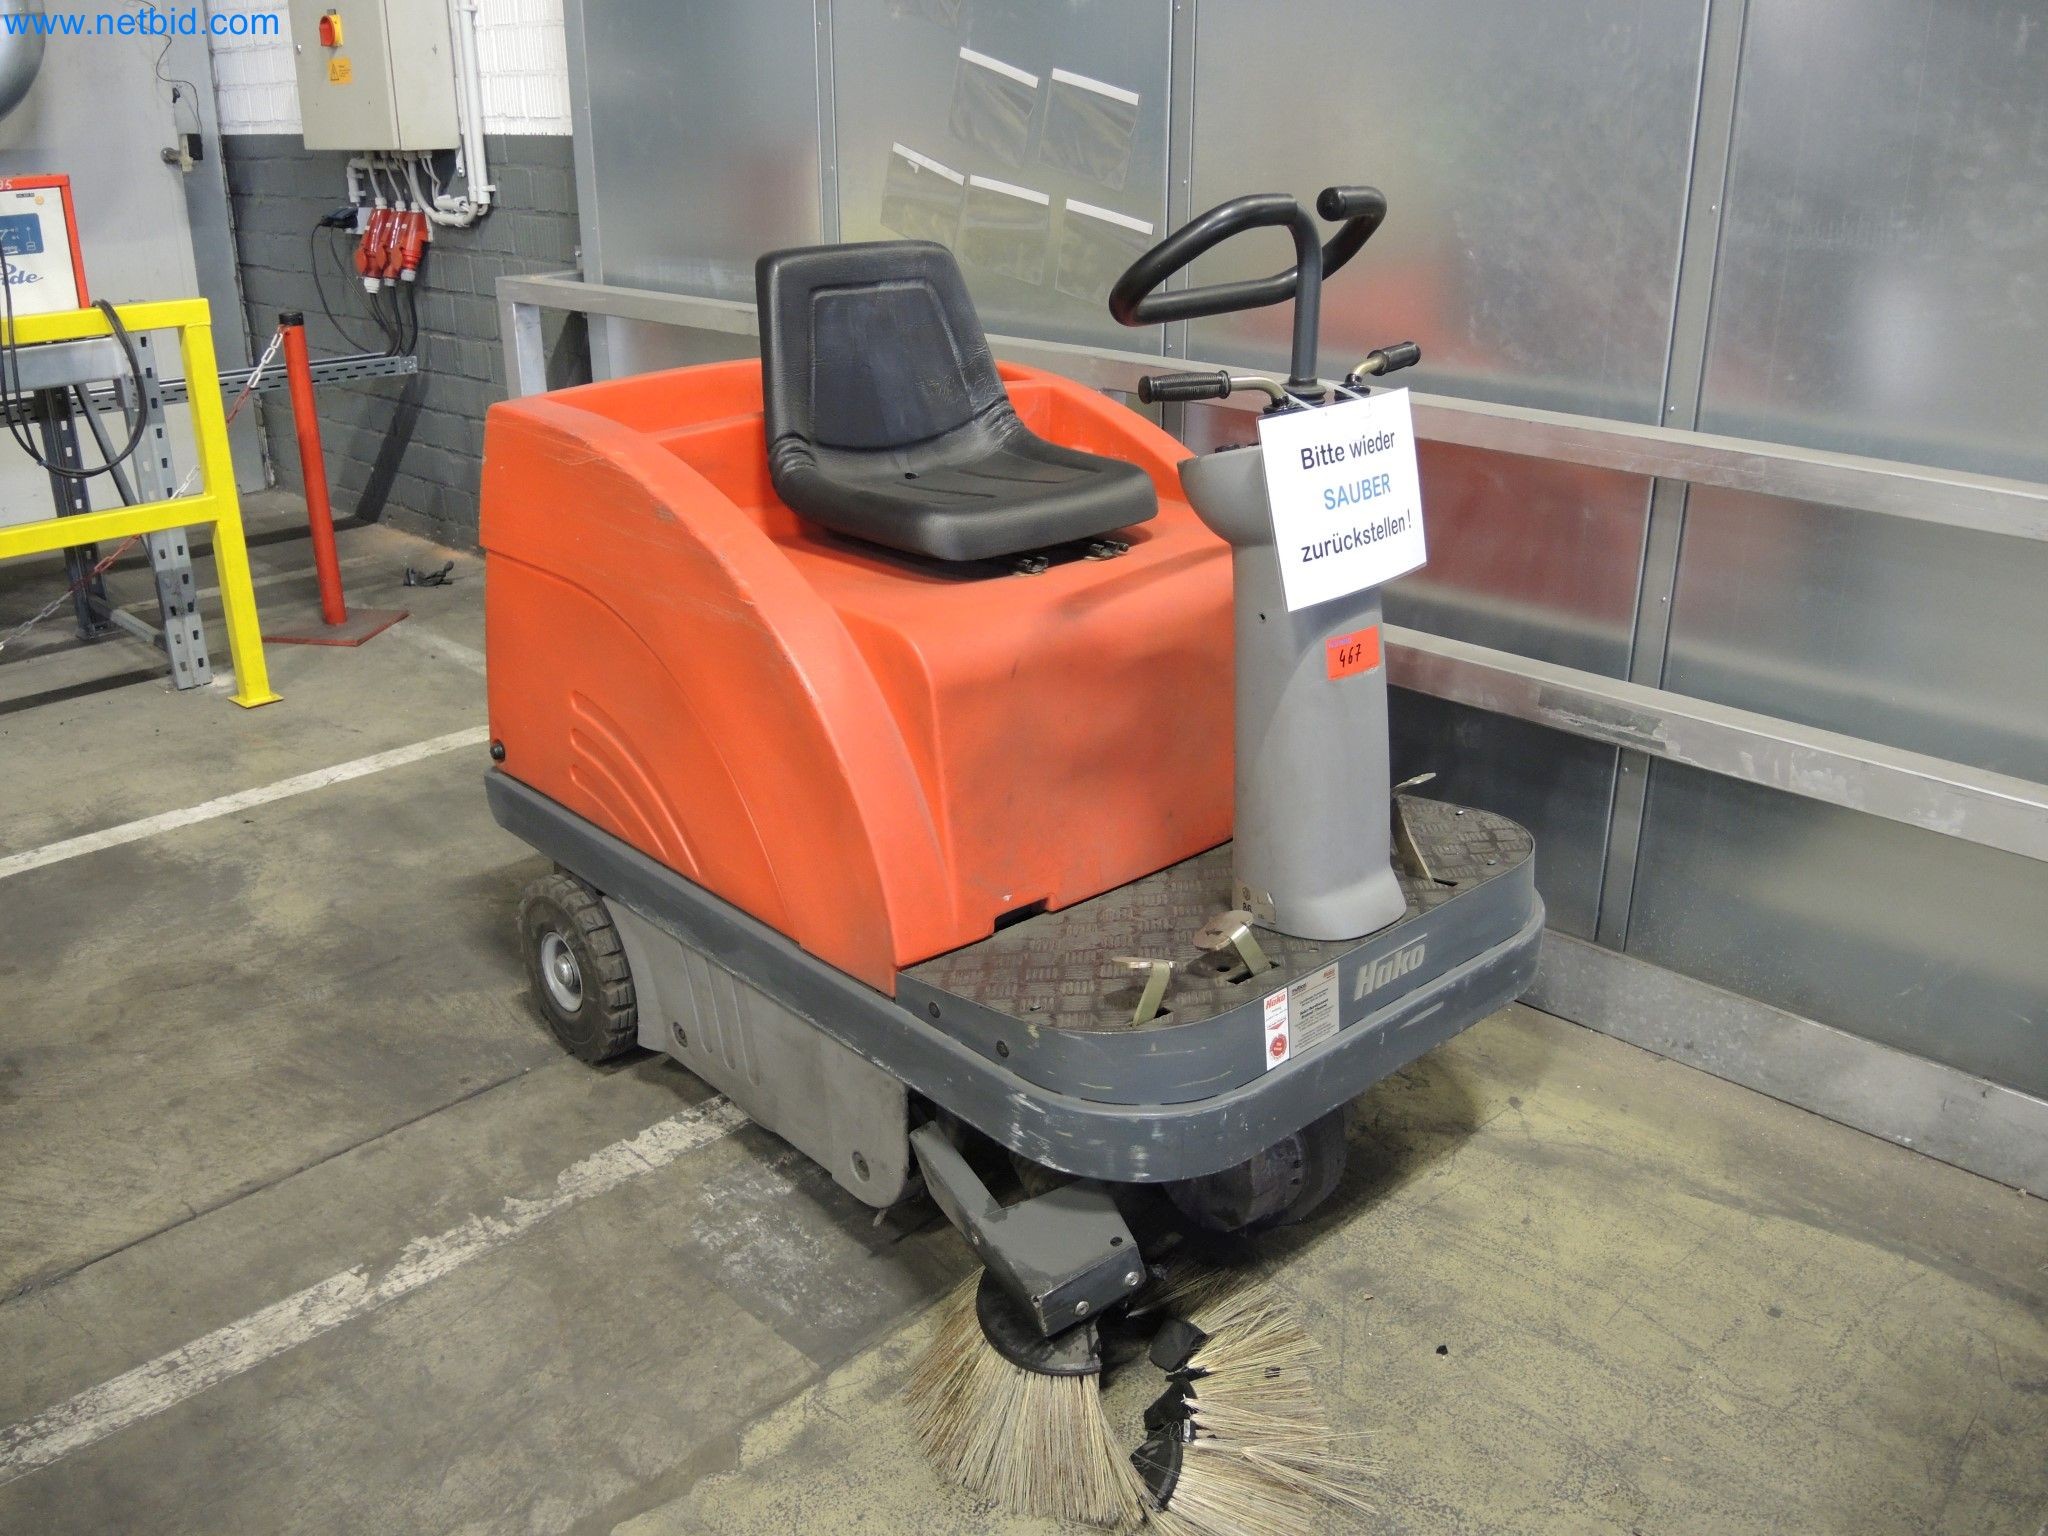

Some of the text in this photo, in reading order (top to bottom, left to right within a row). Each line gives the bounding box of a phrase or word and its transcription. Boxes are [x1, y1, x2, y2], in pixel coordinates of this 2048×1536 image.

[1300, 429, 1395, 470] Bitte wieder
[1323, 472, 1391, 511] SAUBER
[1339, 642, 1362, 668] 467
[1354, 943, 1426, 1002] Hako
[1265, 993, 1286, 1010] Hako
